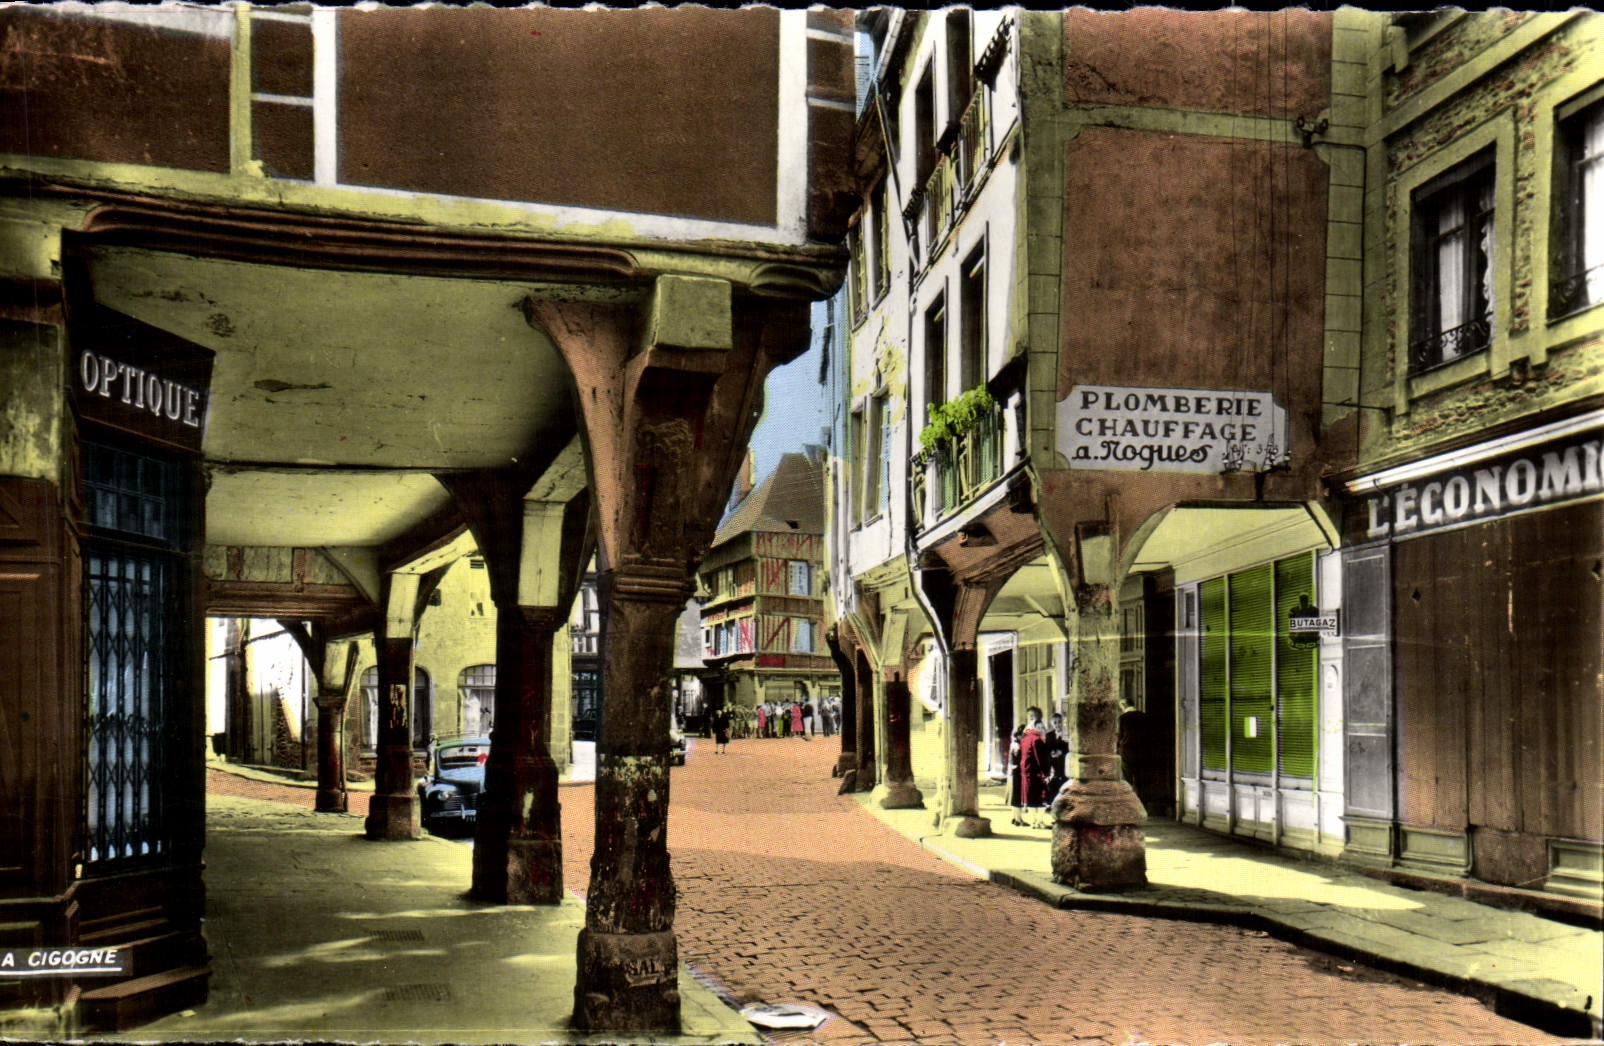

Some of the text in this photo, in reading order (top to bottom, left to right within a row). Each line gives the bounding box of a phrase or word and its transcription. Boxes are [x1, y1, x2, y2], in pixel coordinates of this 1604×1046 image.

[80, 351, 200, 428] OPTIQUE
[1081, 390, 1263, 417] PLOMBERIE
[1075, 417, 1258, 442] CHAUFFAGE
[1367, 440, 1604, 538] L'ÉCONOMI
[1290, 618, 1336, 628] BUTAGAZ
